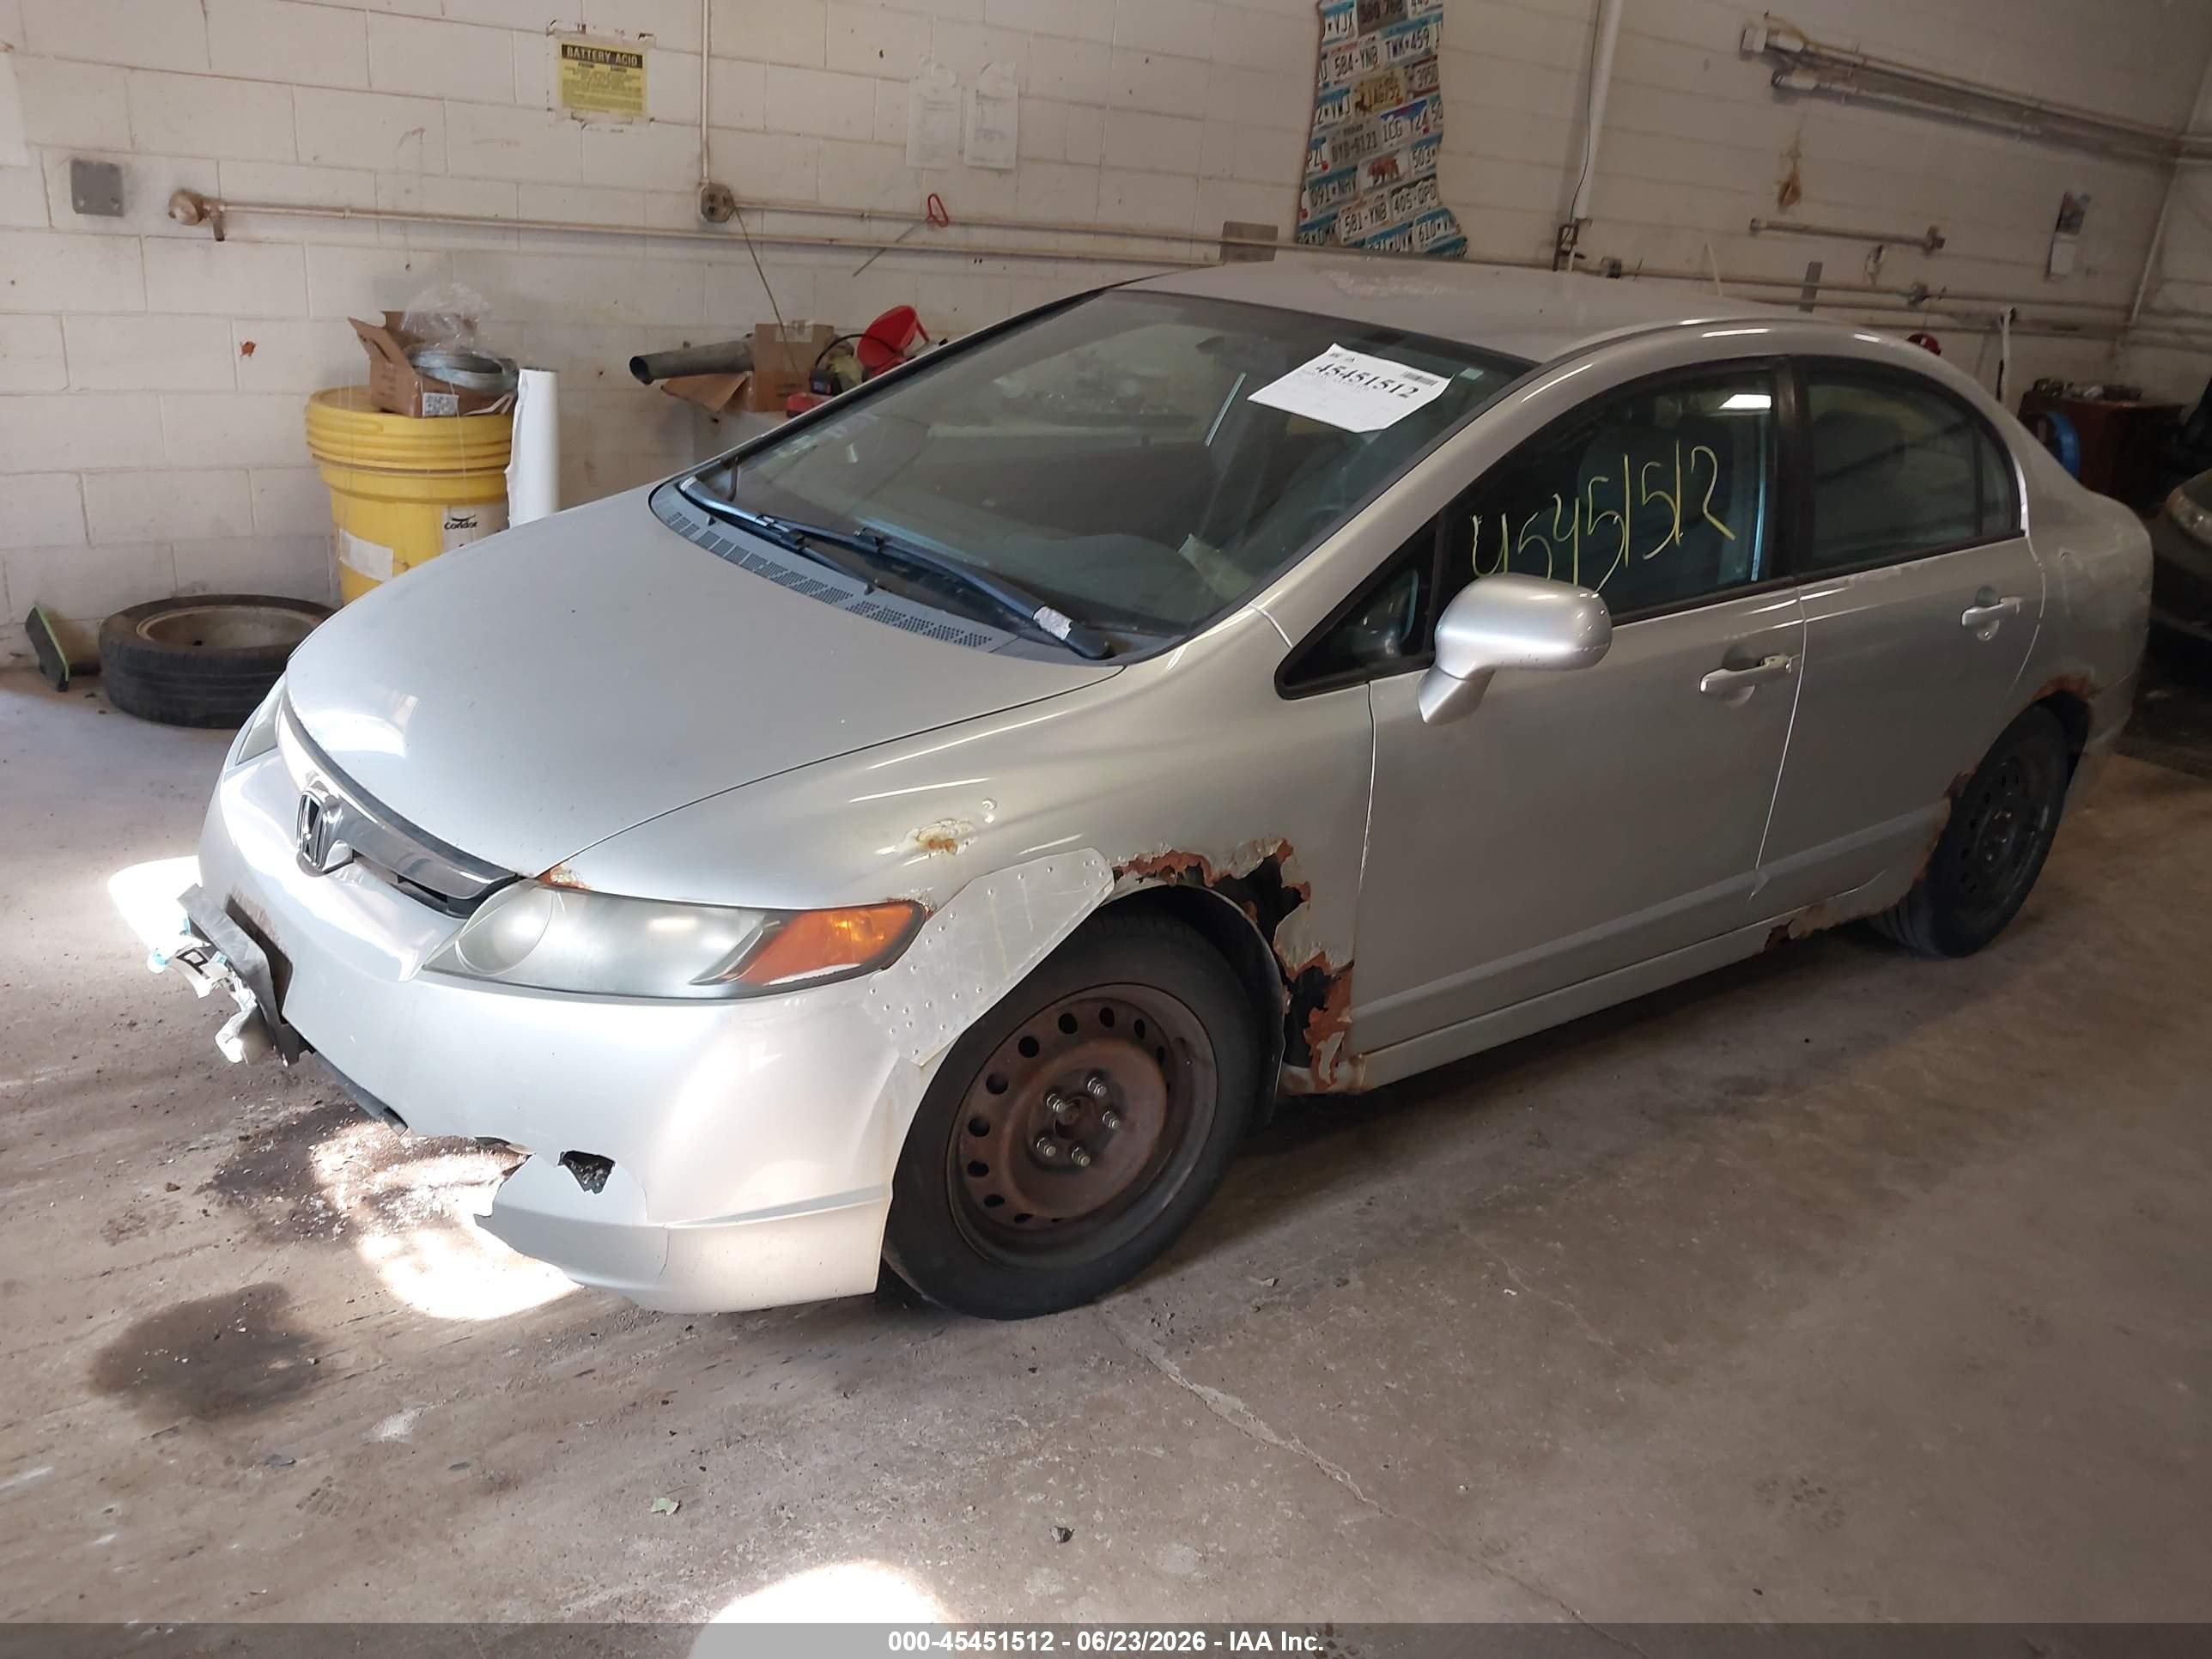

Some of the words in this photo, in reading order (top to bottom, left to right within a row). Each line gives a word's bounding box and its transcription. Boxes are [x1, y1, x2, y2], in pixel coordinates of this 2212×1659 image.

[567, 46, 611, 63] BATTERY
[616, 53, 638, 66] ACID
[1316, 363, 1419, 398] 45451512
[444, 520, 478, 530] Condor
[1470, 439, 1736, 593] 45451512
